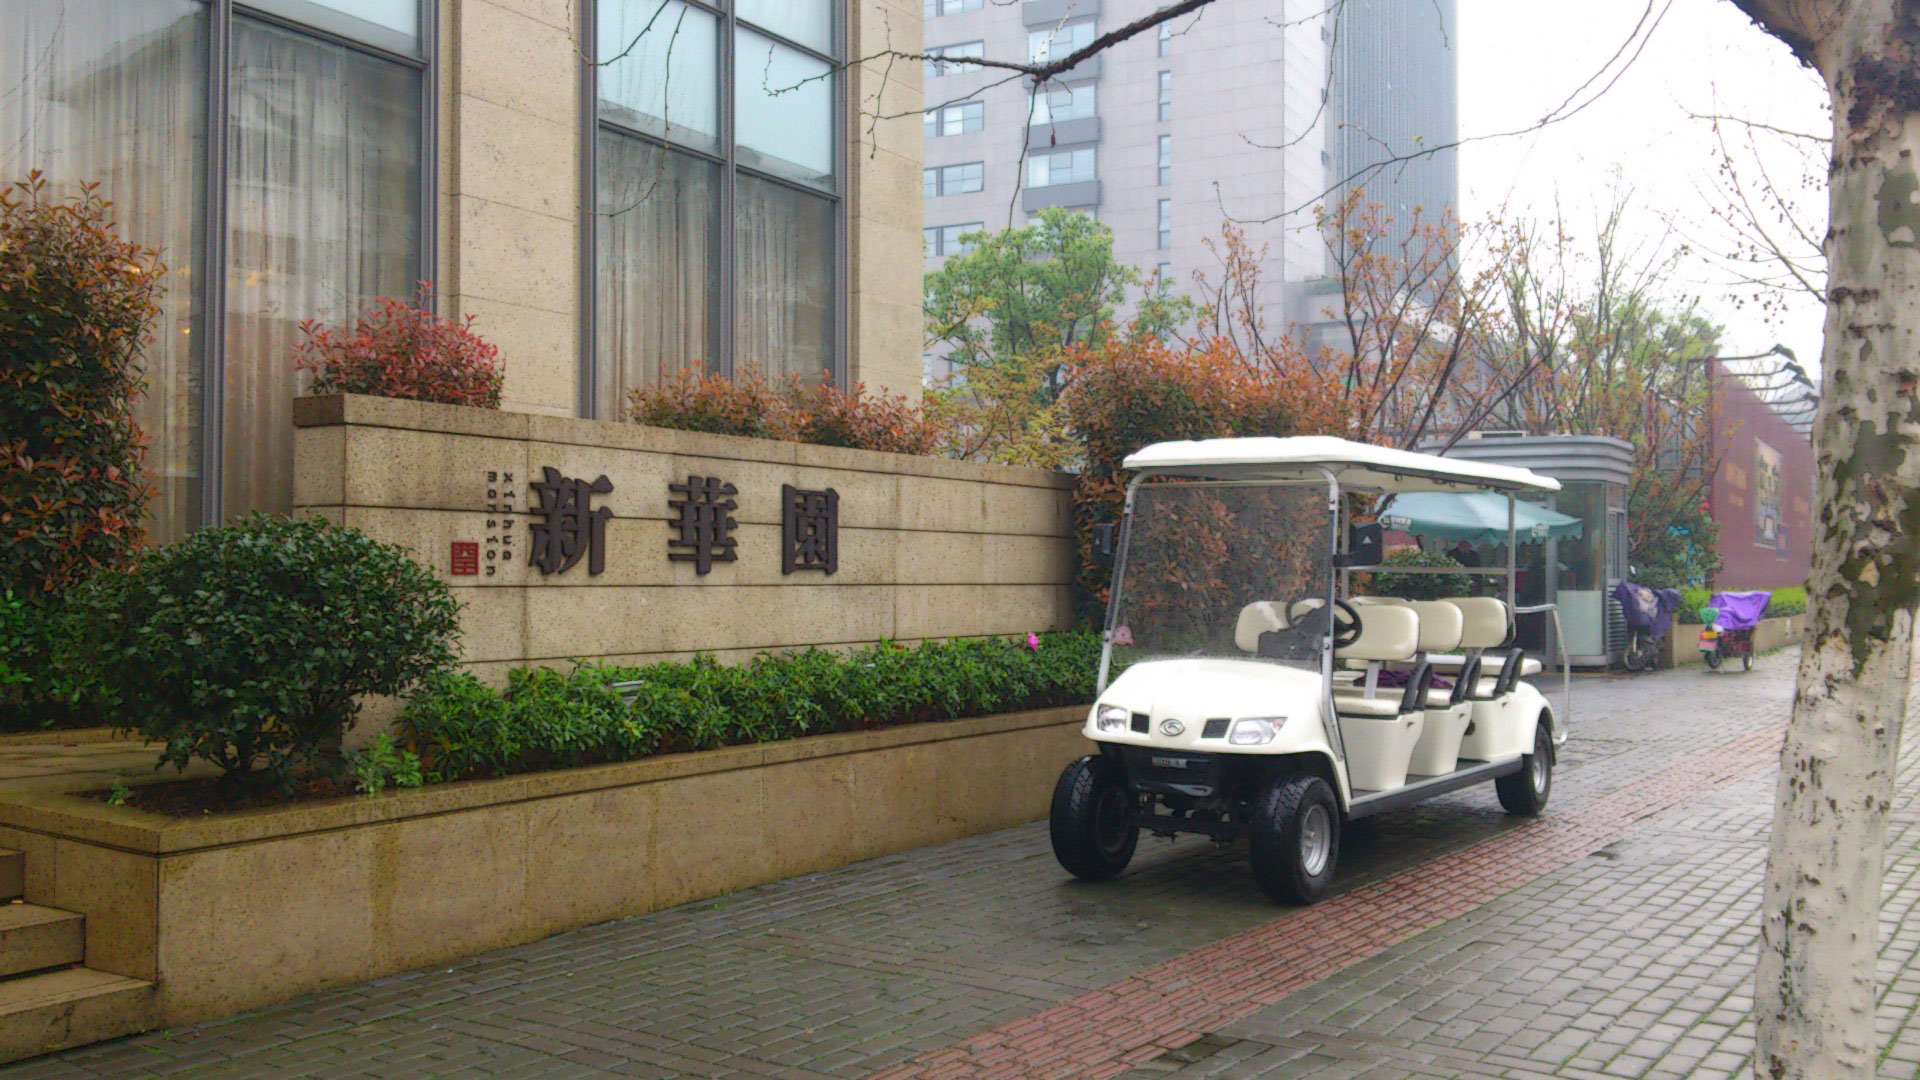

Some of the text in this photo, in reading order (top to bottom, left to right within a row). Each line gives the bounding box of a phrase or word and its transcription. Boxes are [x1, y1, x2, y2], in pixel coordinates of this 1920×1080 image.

[485, 471, 498, 576] mansion
[528, 466, 840, 576] 新華園
